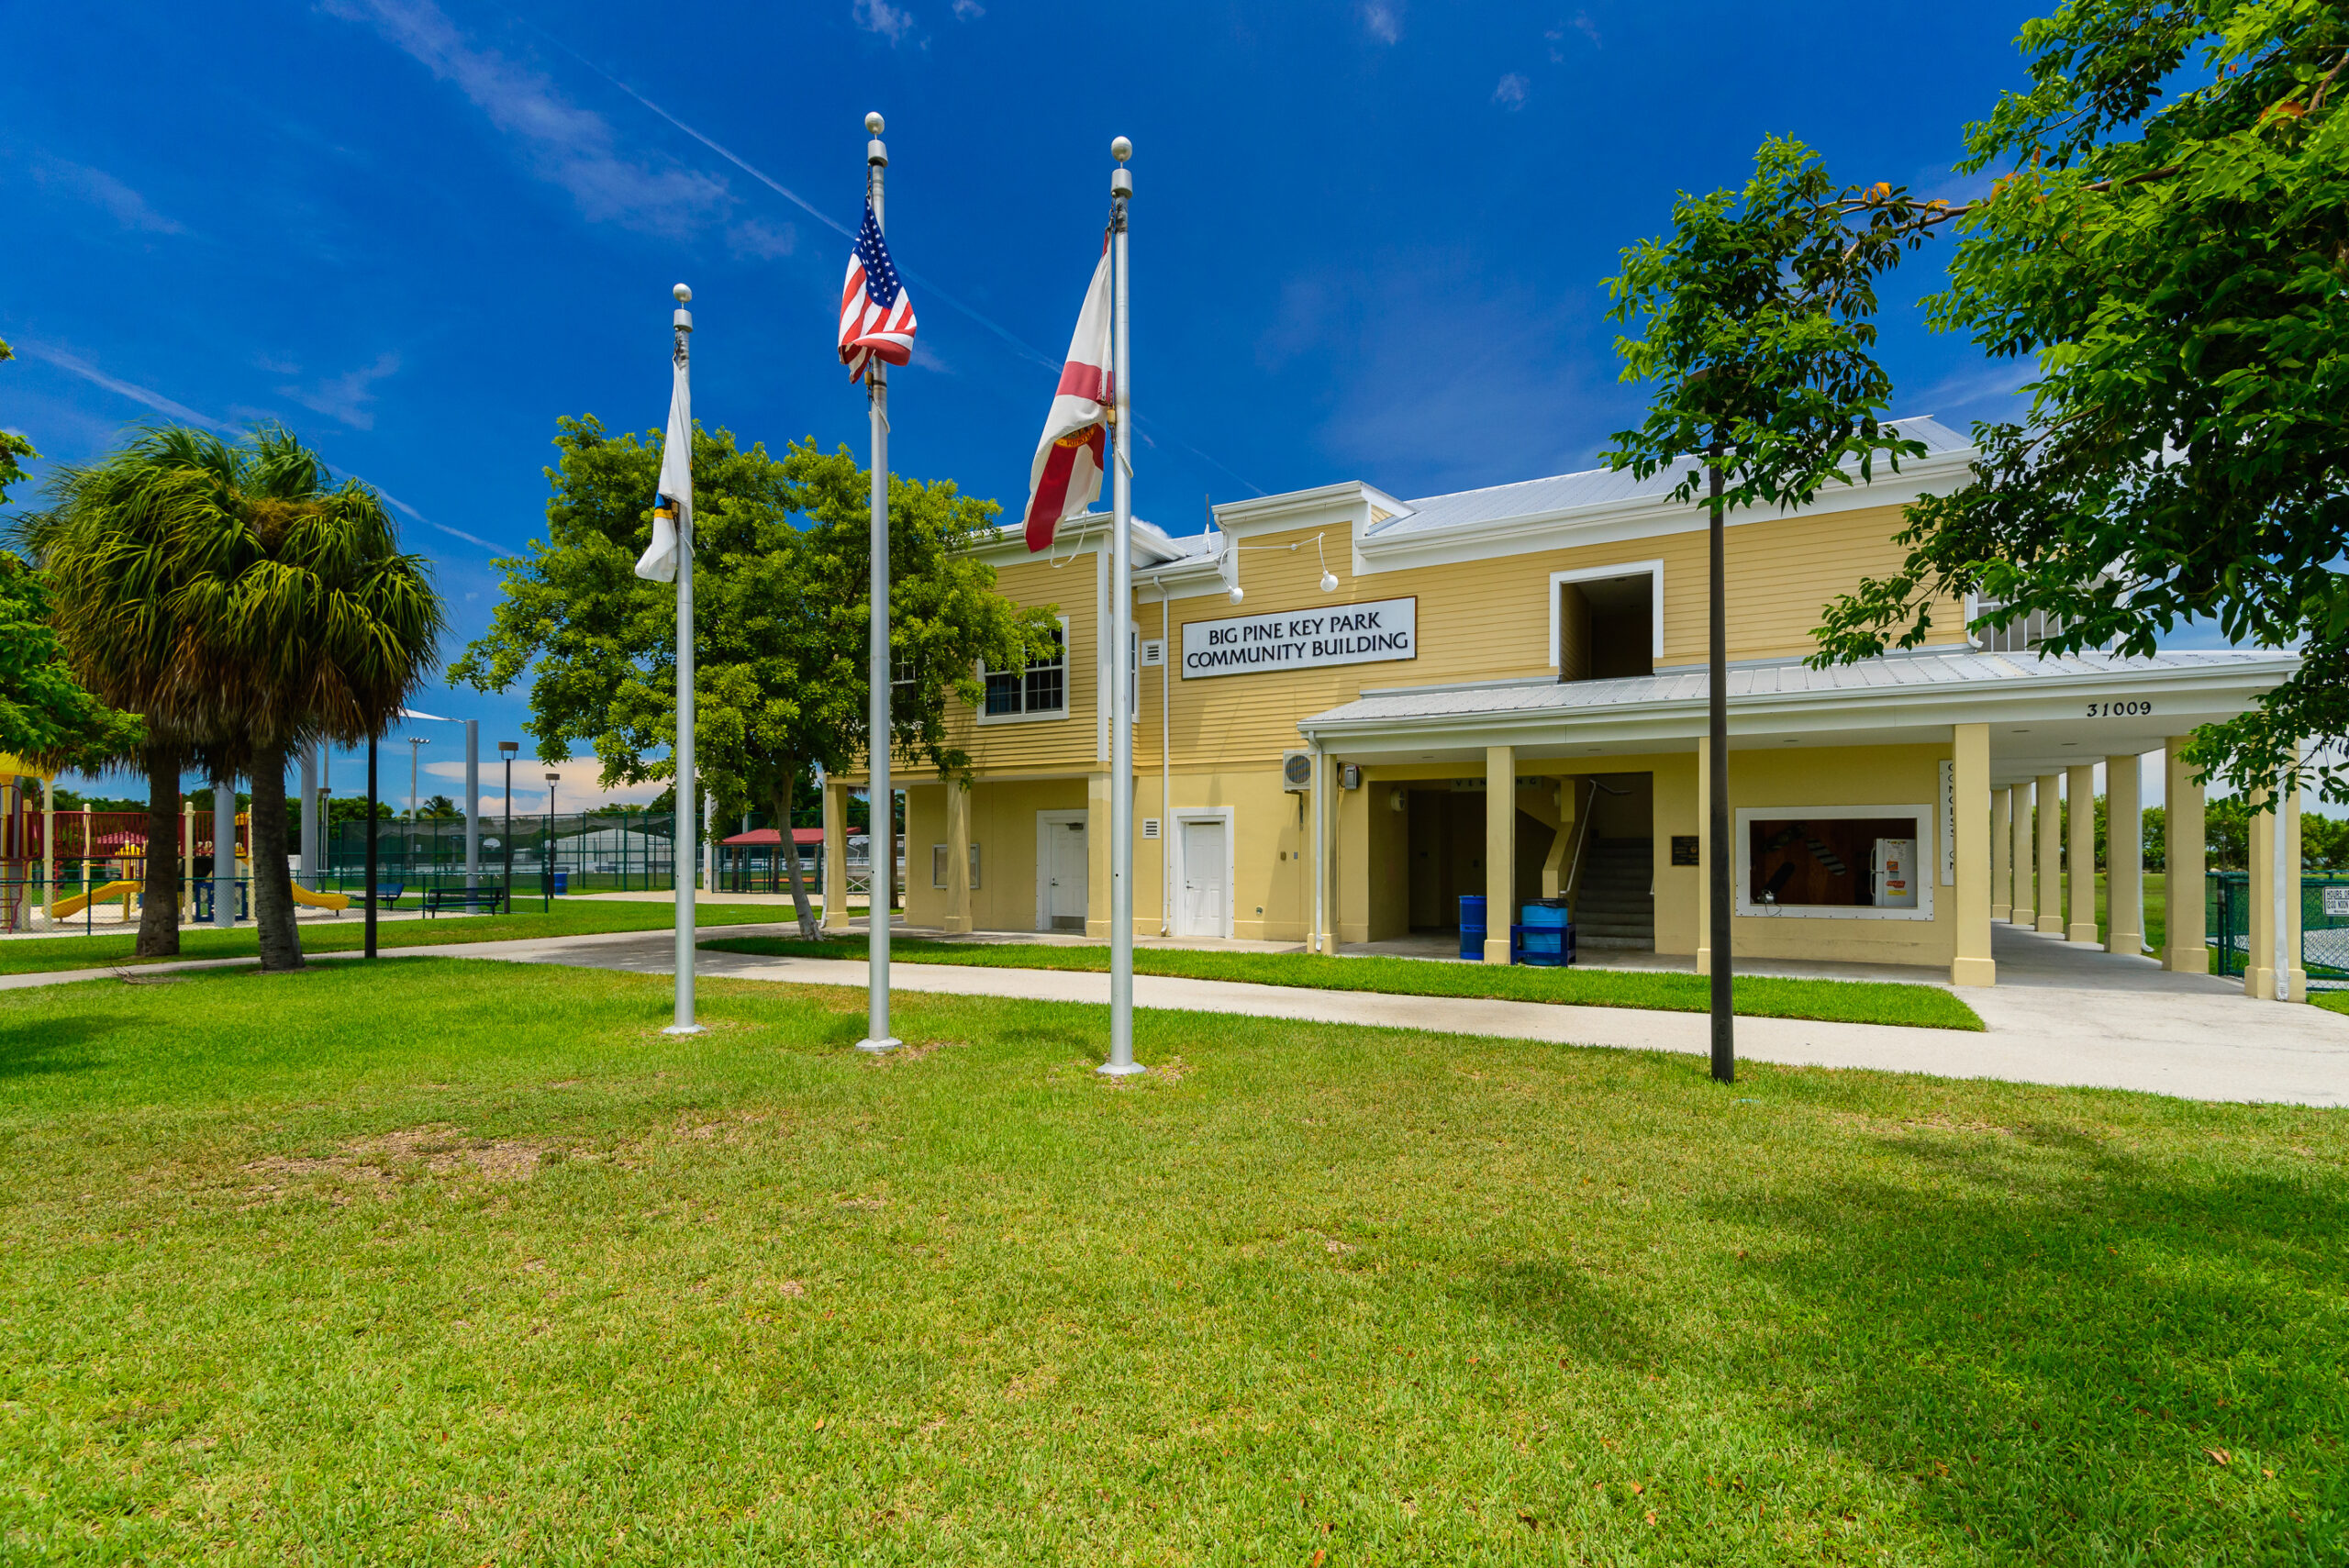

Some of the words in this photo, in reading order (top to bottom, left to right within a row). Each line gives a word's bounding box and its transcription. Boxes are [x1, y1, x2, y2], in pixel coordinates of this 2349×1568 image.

[1208, 628, 1238, 646] BIG
[1242, 622, 1284, 642] PINE
[1289, 617, 1324, 638] KEY
[1330, 611, 1382, 633] PARK
[1186, 642, 1307, 669] COMMUNITY
[1312, 632, 1408, 657] BUILDING
[2087, 701, 2152, 717] 31009
[1455, 777, 1537, 787] VENNG
